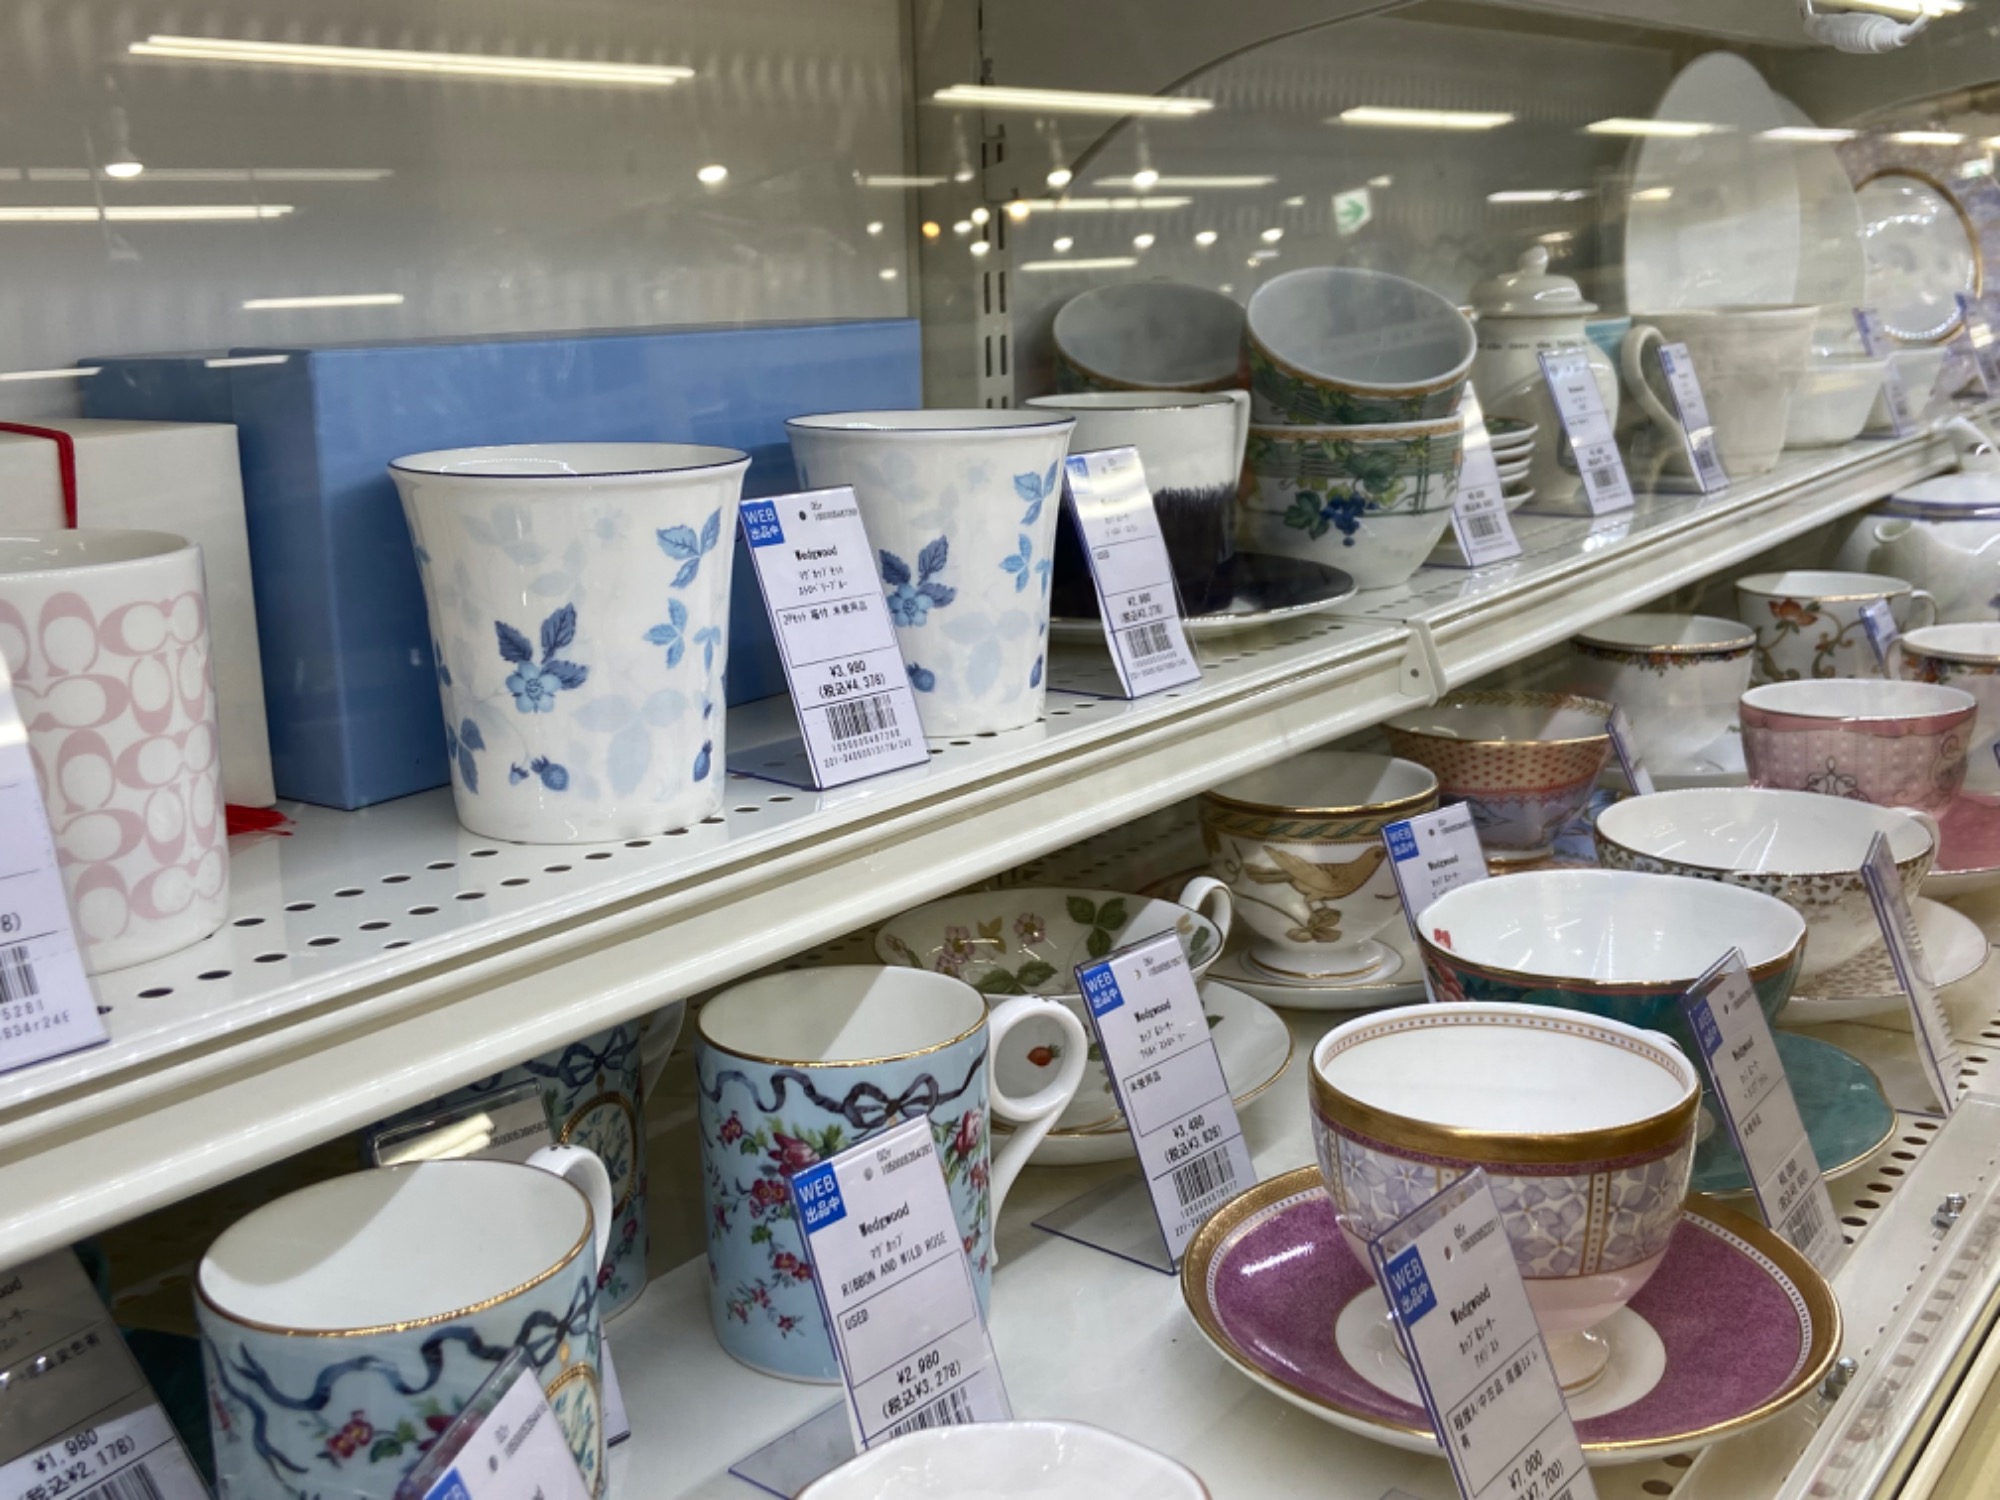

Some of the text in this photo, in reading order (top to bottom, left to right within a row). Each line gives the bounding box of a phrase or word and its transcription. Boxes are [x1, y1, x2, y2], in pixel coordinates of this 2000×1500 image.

[744, 508, 776, 525] WEB
[795, 545, 837, 561] Wedgwood
[1086, 971, 1114, 993] WEB
[1134, 998, 1171, 1023] Wedgwood
[799, 1174, 835, 1204] WEB
[805, 1195, 841, 1224] 出品中
[858, 1201, 910, 1237] Wedgwood
[841, 1231, 947, 1297] RIBBON AND WILD ROSE
[1392, 1257, 1423, 1291] WEB
[1450, 1283, 1491, 1326] Wedgwood
[845, 1308, 869, 1331] USED
